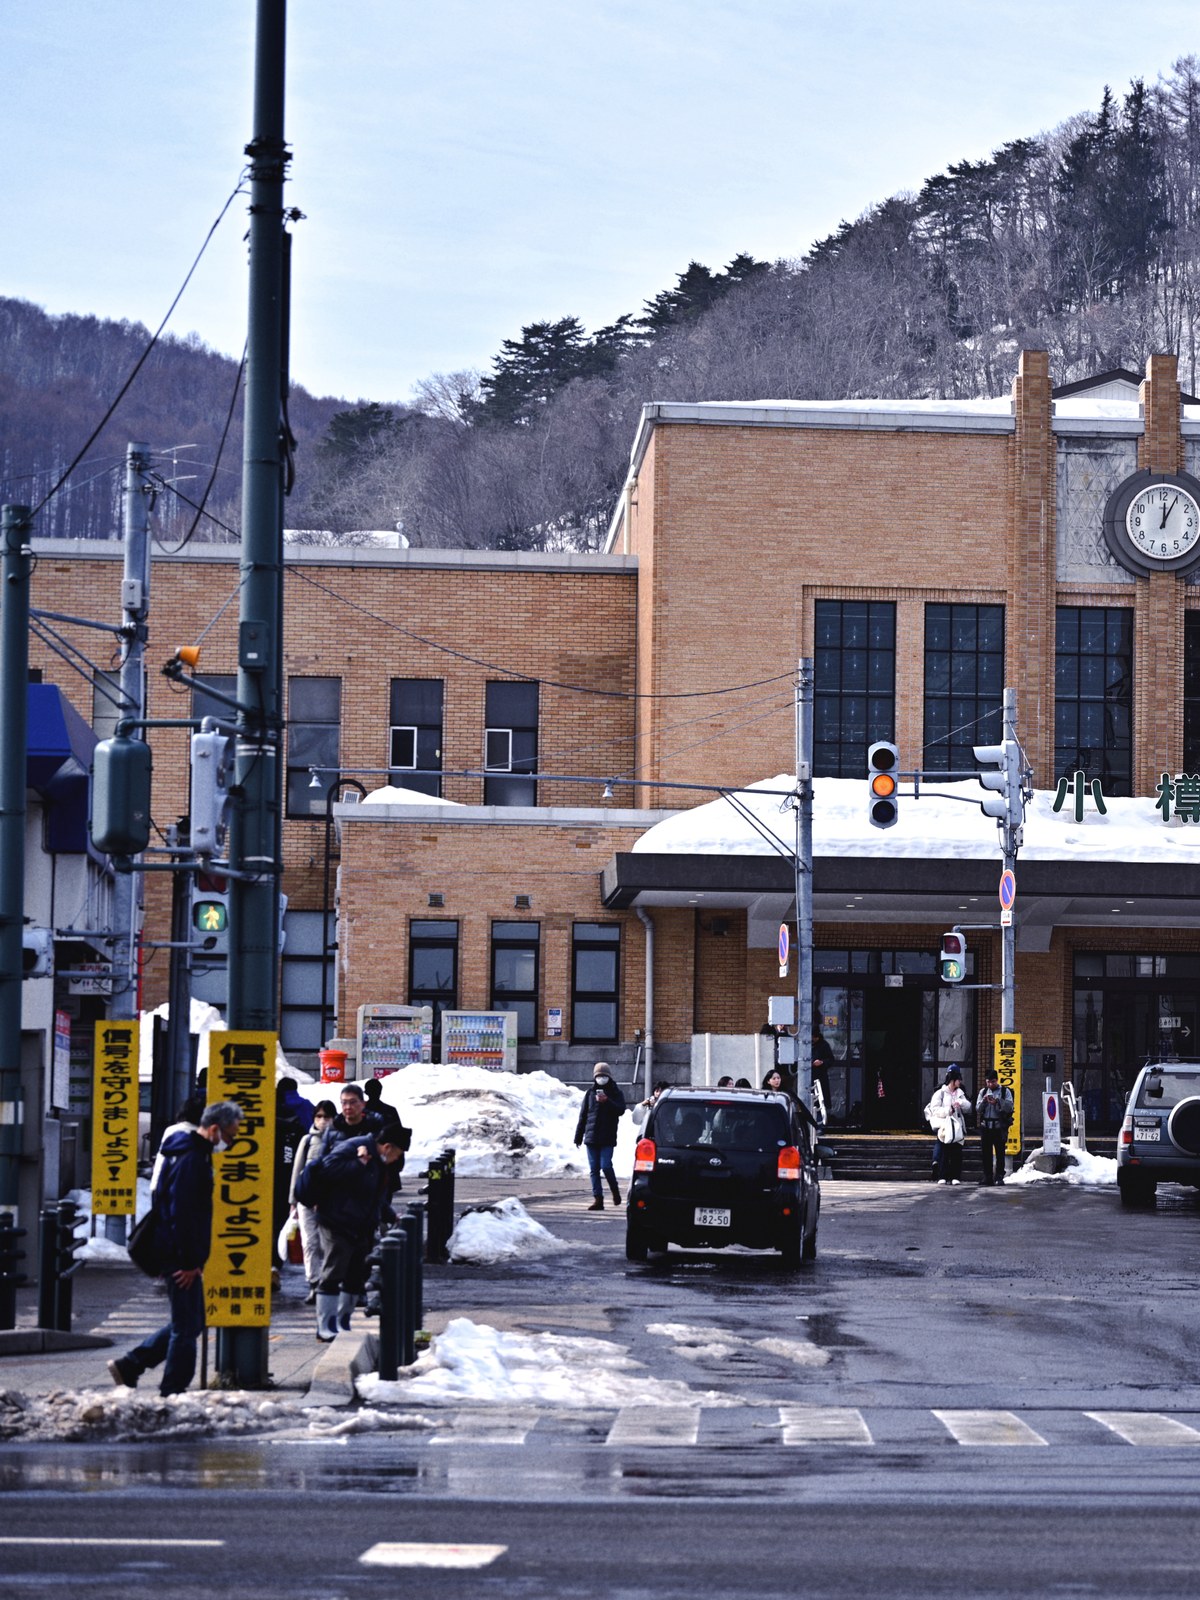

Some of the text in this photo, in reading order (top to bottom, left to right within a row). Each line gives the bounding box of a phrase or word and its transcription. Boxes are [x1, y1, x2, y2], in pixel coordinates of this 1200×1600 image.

[1148, 495, 1154, 504] 11
[1160, 492, 1168, 501] 12
[1137, 504, 1145, 513] 10
[1184, 504, 1189, 513] 2
[1135, 517, 1141, 526] 9
[1187, 518, 1193, 527] 3
[1139, 531, 1145, 540] 8
[1182, 531, 1189, 540] 4
[1150, 540, 1155, 549] 7
[1161, 543, 1167, 552] 6
[1173, 540, 1179, 549] 5
[101, 1028, 133, 1182] 信号を守りましょう！
[702, 1215, 729, 1225] 82-50
